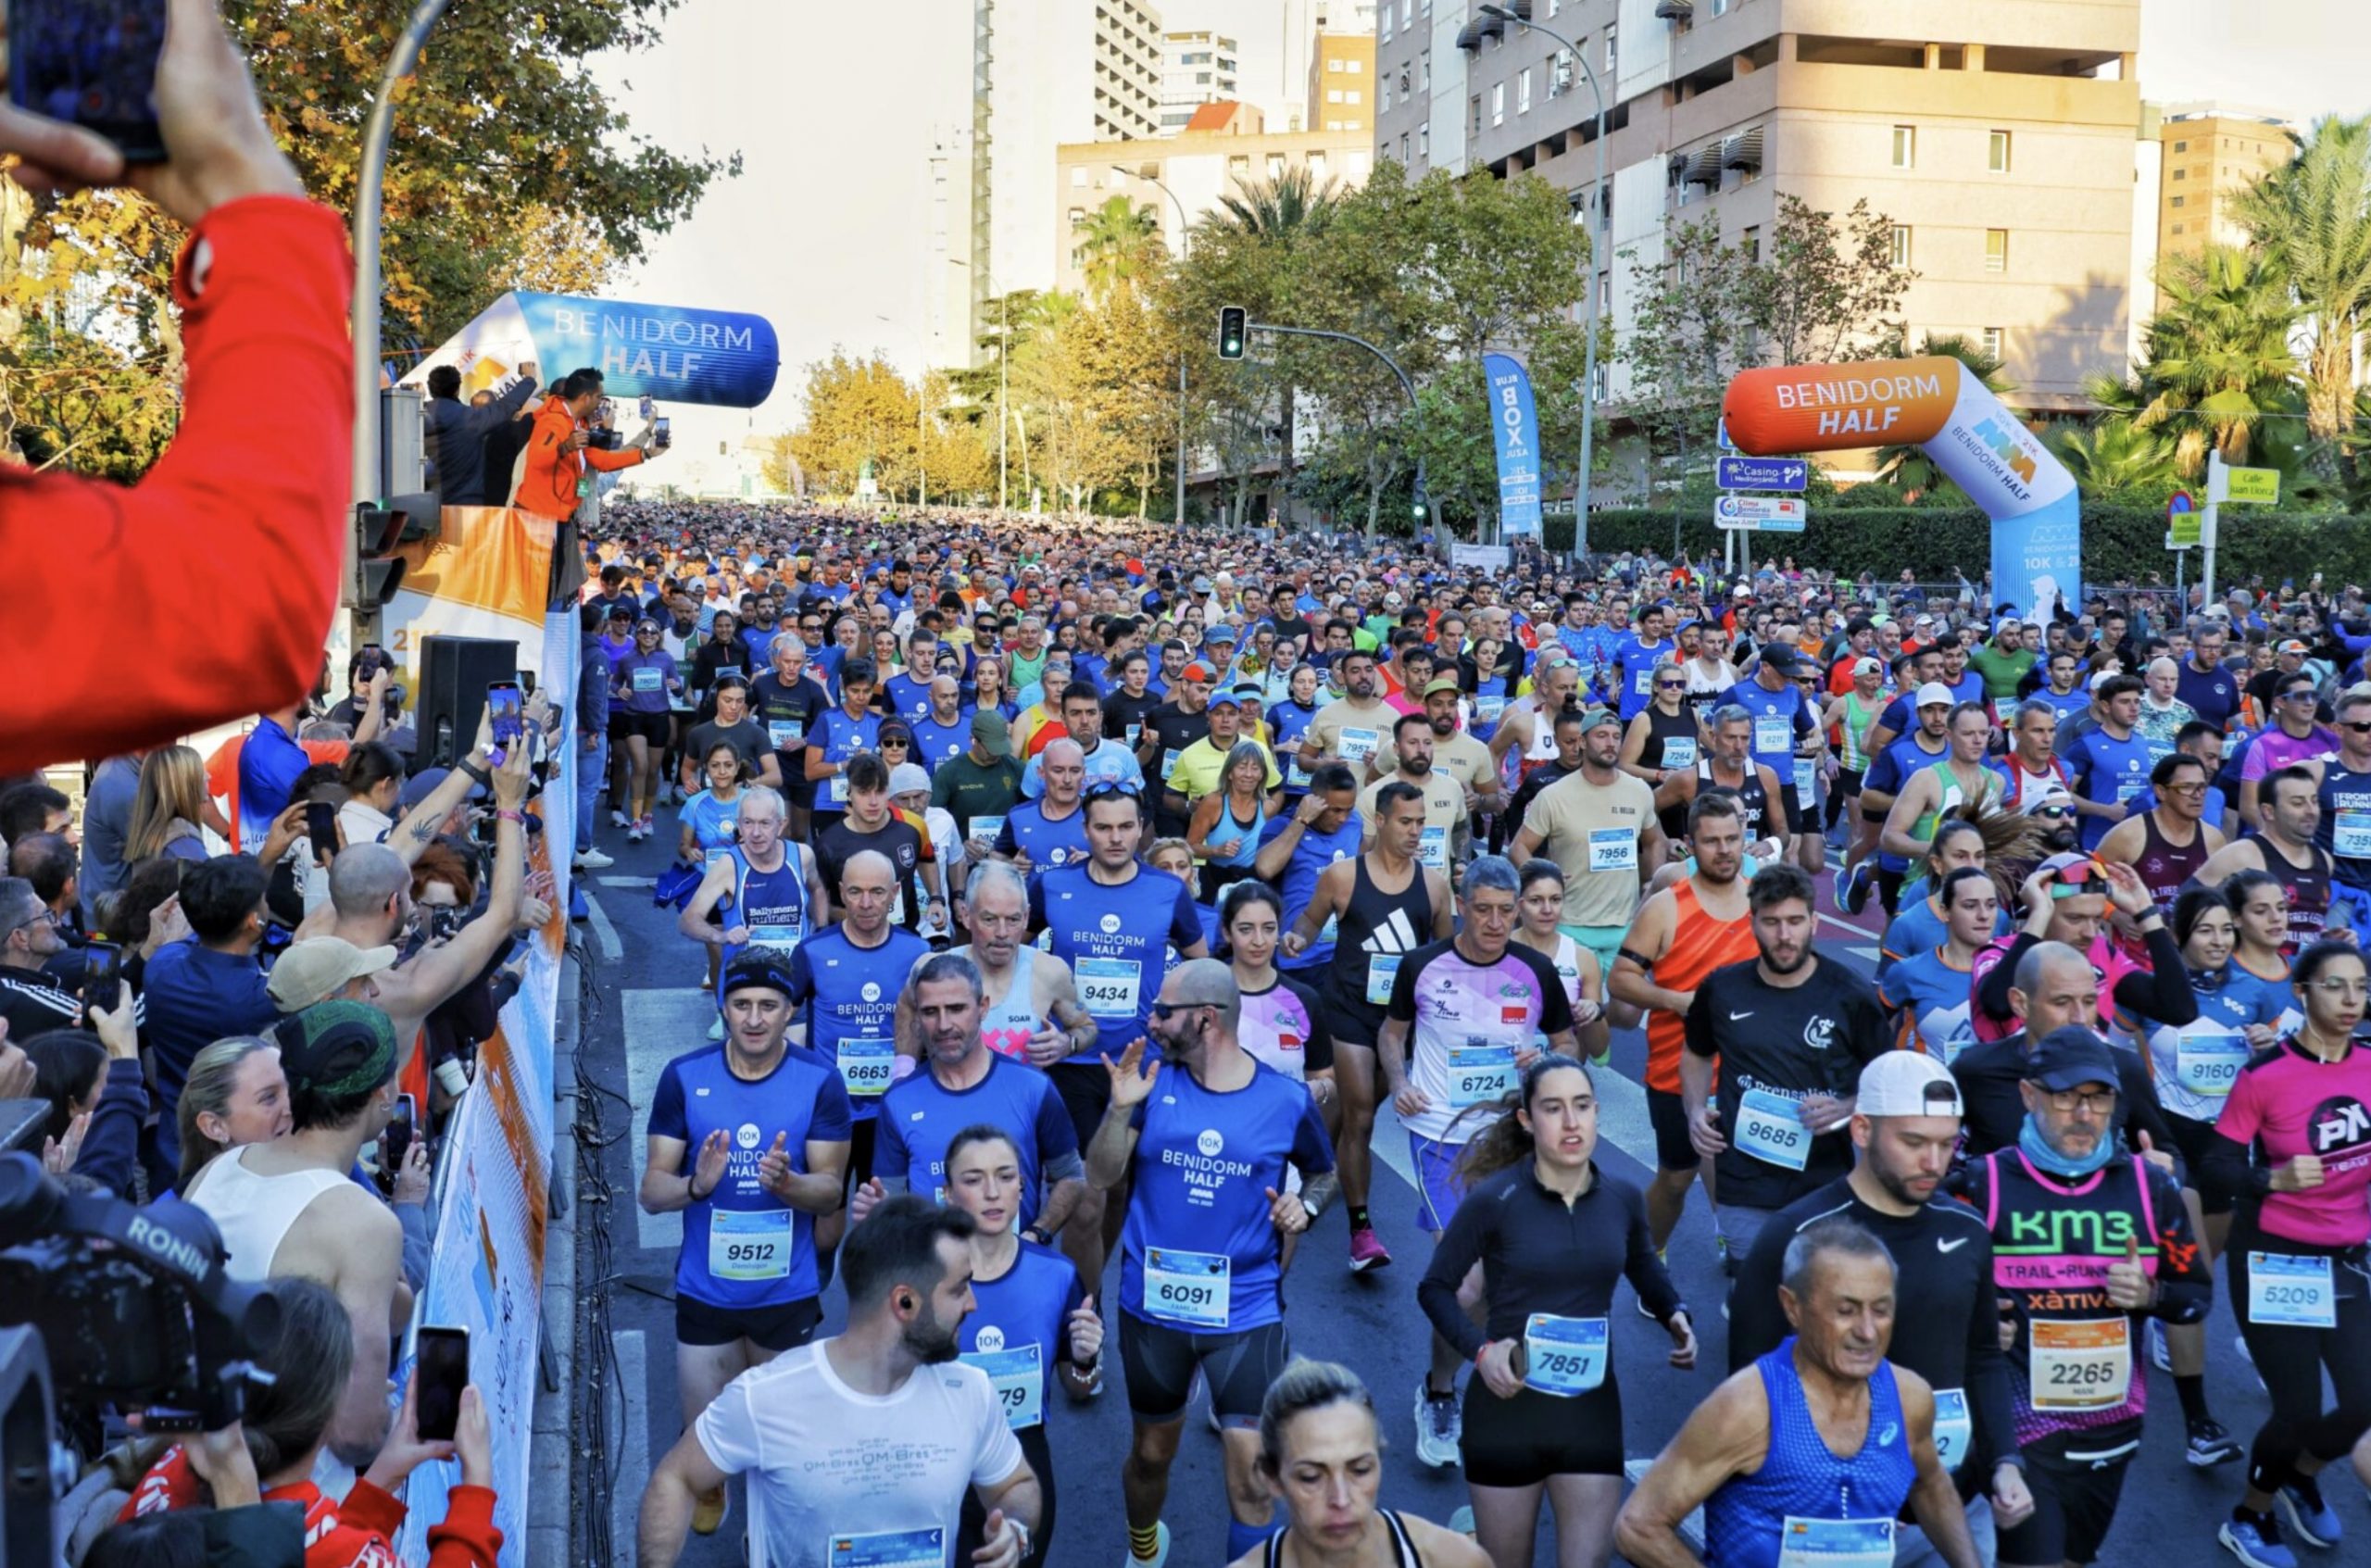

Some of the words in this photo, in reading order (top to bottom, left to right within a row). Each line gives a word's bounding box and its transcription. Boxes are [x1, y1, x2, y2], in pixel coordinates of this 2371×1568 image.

[556, 309, 752, 352] BENIDORM
[602, 345, 703, 381] HALF
[1776, 374, 1941, 409] BENIDORM
[1818, 407, 1901, 435] HALF
[2022, 439, 2039, 457] 21K
[1744, 466, 1778, 476] Casino
[1951, 426, 2004, 479] BENIDORM
[2001, 475, 2031, 502] HALF
[2243, 473, 2264, 483] Calle
[2230, 484, 2249, 495] Juan
[2025, 558, 2051, 570] 10K
[1346, 743, 1370, 753] 7957
[1669, 750, 1690, 761] 7264
[1598, 847, 1628, 859] 7956
[749, 905, 798, 916] Ballymena
[749, 913, 798, 924] runners
[1073, 932, 1146, 947] BENIDORM
[1092, 945, 1124, 955] HALF
[863, 988, 879, 997] 10K
[1085, 985, 1128, 1001] 9434
[855, 1014, 885, 1024] HALF
[847, 1065, 890, 1079] 6663
[2192, 1064, 2235, 1078] 9160
[1461, 1075, 1505, 1092] 6724
[1755, 1081, 1838, 1102] Prensalink
[739, 1132, 759, 1141] 10K
[1748, 1121, 1799, 1148] 9685
[1200, 1137, 1221, 1148] 10K
[1162, 1149, 1251, 1177] BENIDORM
[729, 1166, 762, 1178] HAL
[1184, 1170, 1225, 1188] HALF
[128, 1214, 209, 1282] RONIN
[727, 1244, 774, 1261] 9512
[1160, 1285, 1212, 1305] 6091
[2264, 1286, 2319, 1305] 5209
[979, 1336, 1001, 1348] 10K
[1537, 1352, 1590, 1375] 7851
[2050, 1362, 2114, 1385] 2265
